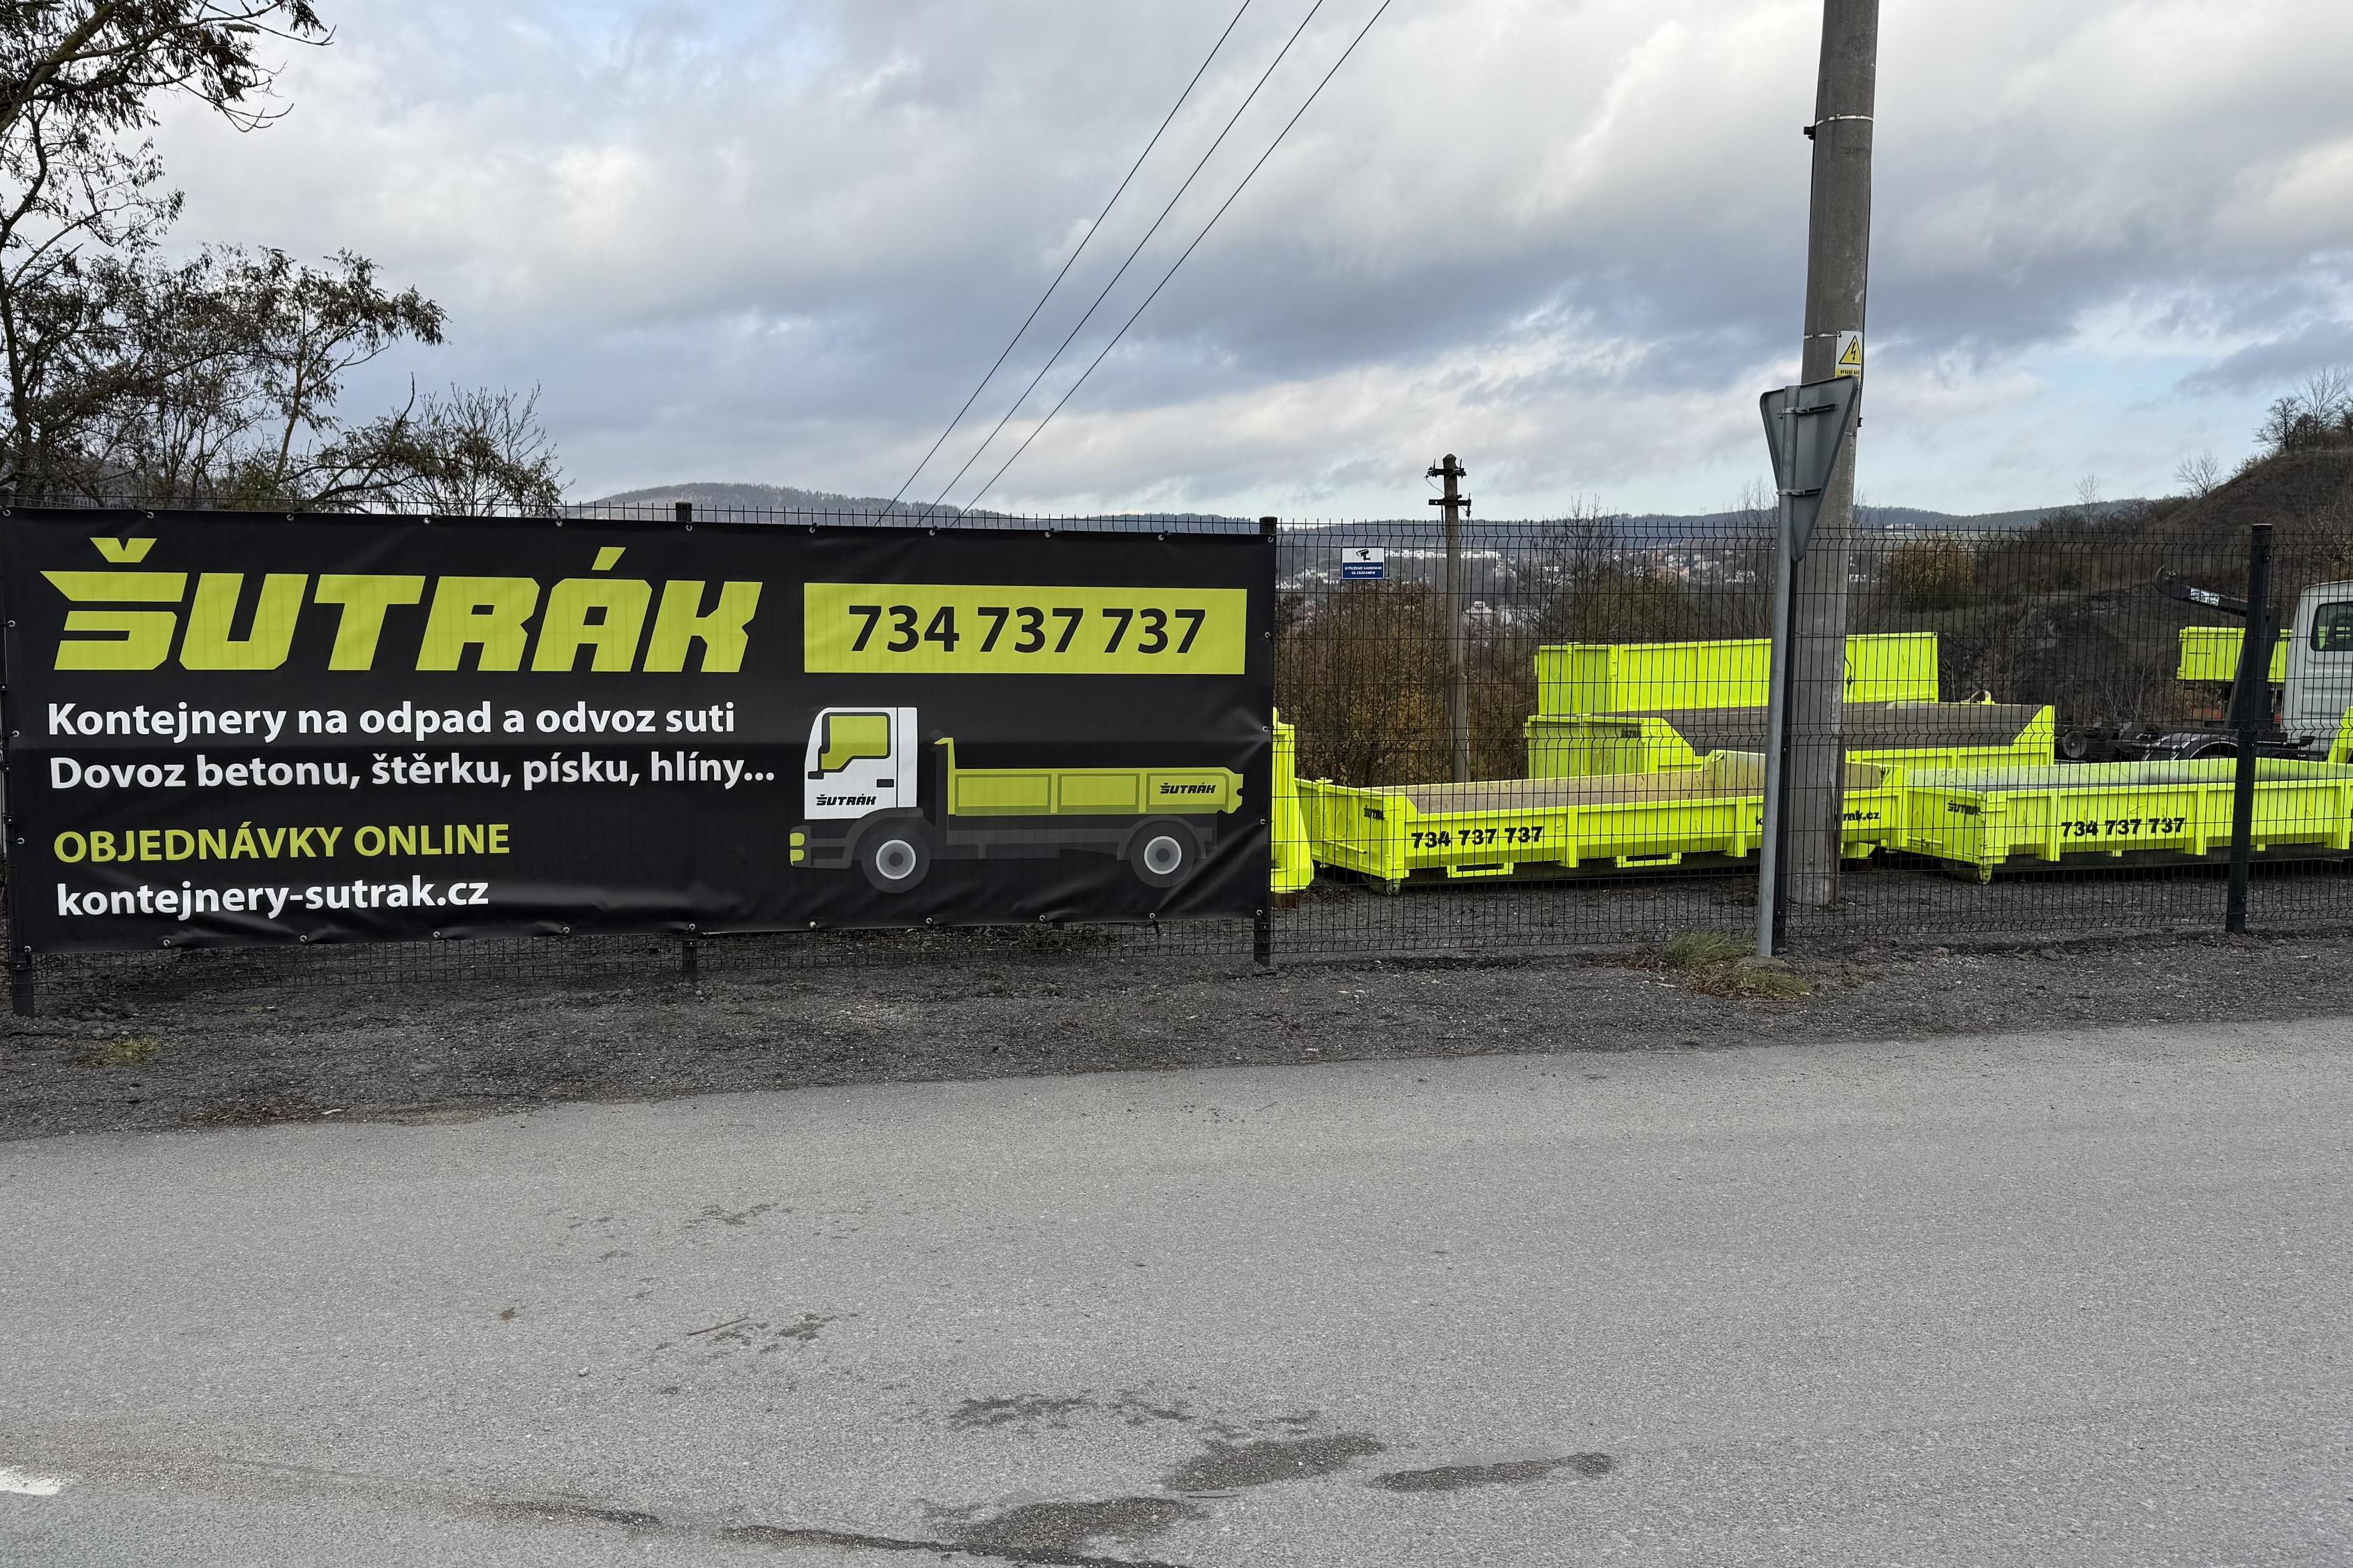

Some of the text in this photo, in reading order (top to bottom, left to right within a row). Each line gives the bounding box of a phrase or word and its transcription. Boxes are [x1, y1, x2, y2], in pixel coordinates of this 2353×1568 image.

[40, 537, 762, 673] ŠUTRÁK
[849, 605, 1205, 654] 734 737 737
[48, 701, 734, 743] Kontejnery na odpad a odvoz suti
[50, 751, 775, 791] Dovoz betonu, štěrku, písku, hlíny...
[1160, 782, 1216, 794] ŠUTRÁK
[816, 793, 877, 806] ŠUTRÁK
[54, 822, 510, 863] OBJEDNÁVKY ONLINE
[1411, 826, 1544, 849] 734 737 737
[2061, 816, 2185, 837] 734 737 737
[57, 874, 489, 921] kontejnery-sutrak.cz
